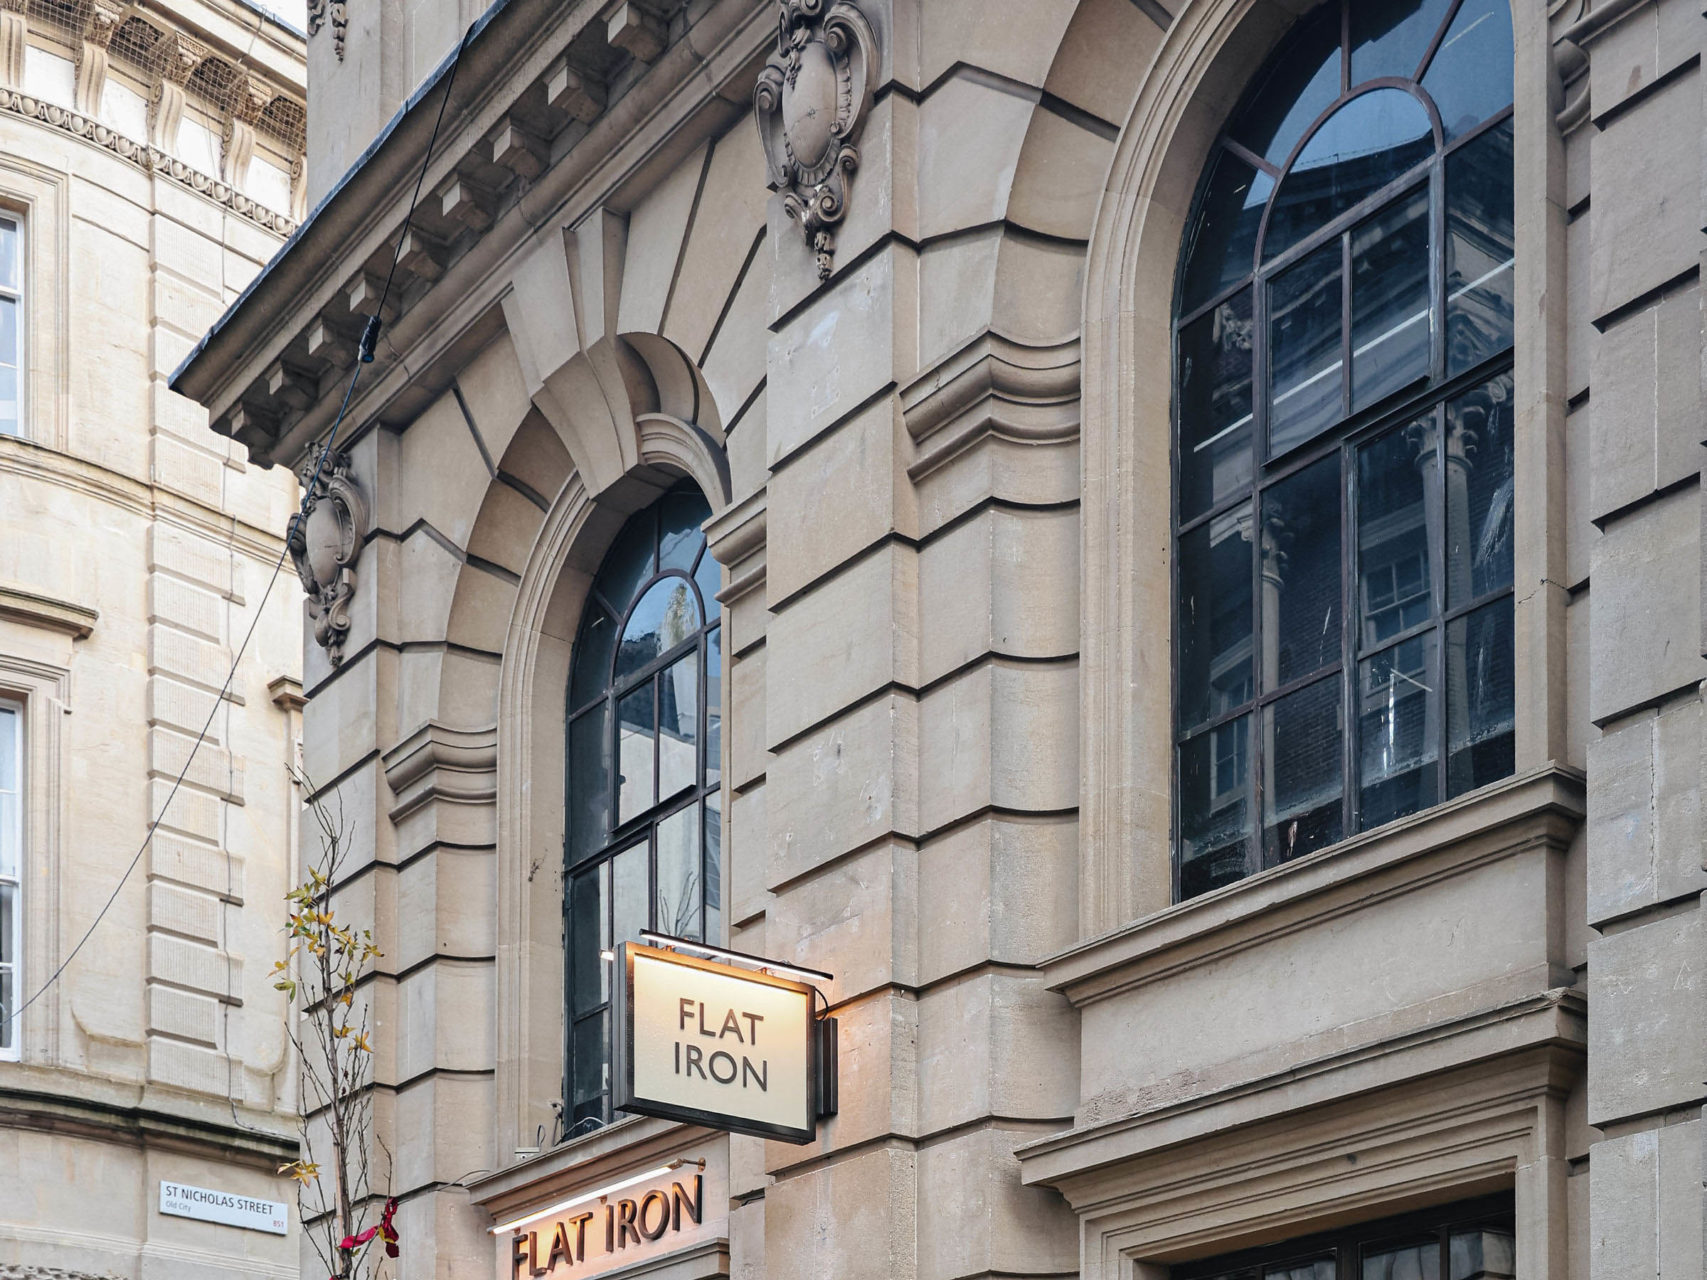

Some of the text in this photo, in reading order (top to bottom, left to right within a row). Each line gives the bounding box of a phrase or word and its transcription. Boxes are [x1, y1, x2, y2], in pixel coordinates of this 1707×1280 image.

[679, 997, 764, 1046] FLAT
[674, 1041, 768, 1092] IRON
[165, 1185, 274, 1215] ST NICHOLAS STREET
[165, 1201, 191, 1212] Old City
[605, 1174, 703, 1252] IRON
[272, 1220, 284, 1228] BS1
